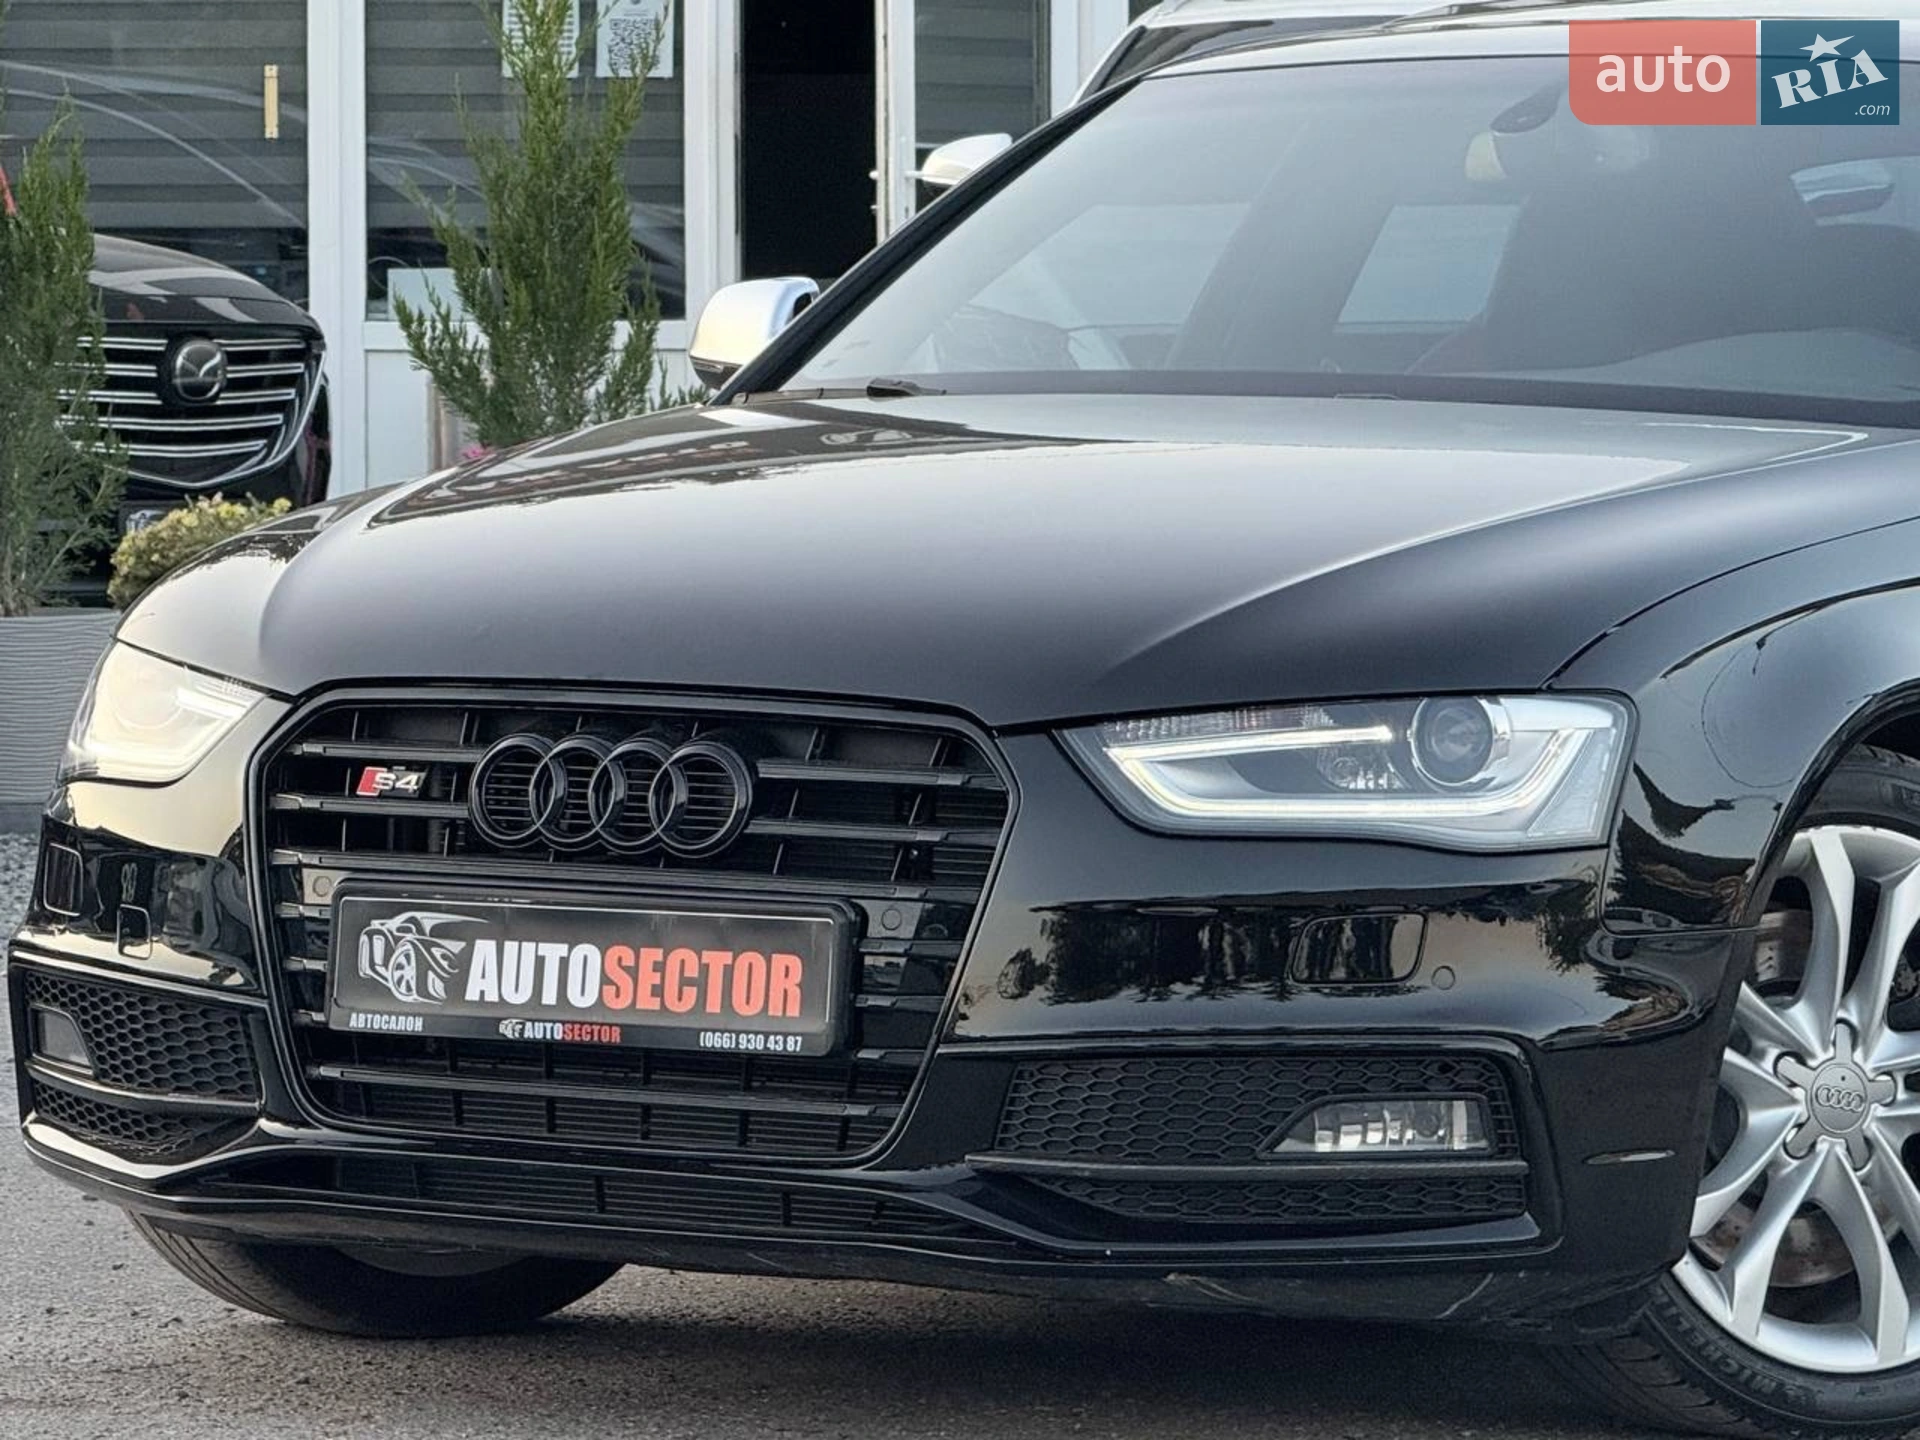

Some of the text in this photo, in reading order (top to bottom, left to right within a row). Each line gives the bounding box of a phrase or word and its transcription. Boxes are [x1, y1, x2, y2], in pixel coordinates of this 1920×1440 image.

[372, 771, 419, 793] S4
[465, 939, 802, 1018] AUTOSECTOR
[349, 1012, 424, 1032] АВТОСАЛОН
[524, 1021, 620, 1043] AUTOSECTOR
[700, 1031, 803, 1053] (066) 930 43 87
